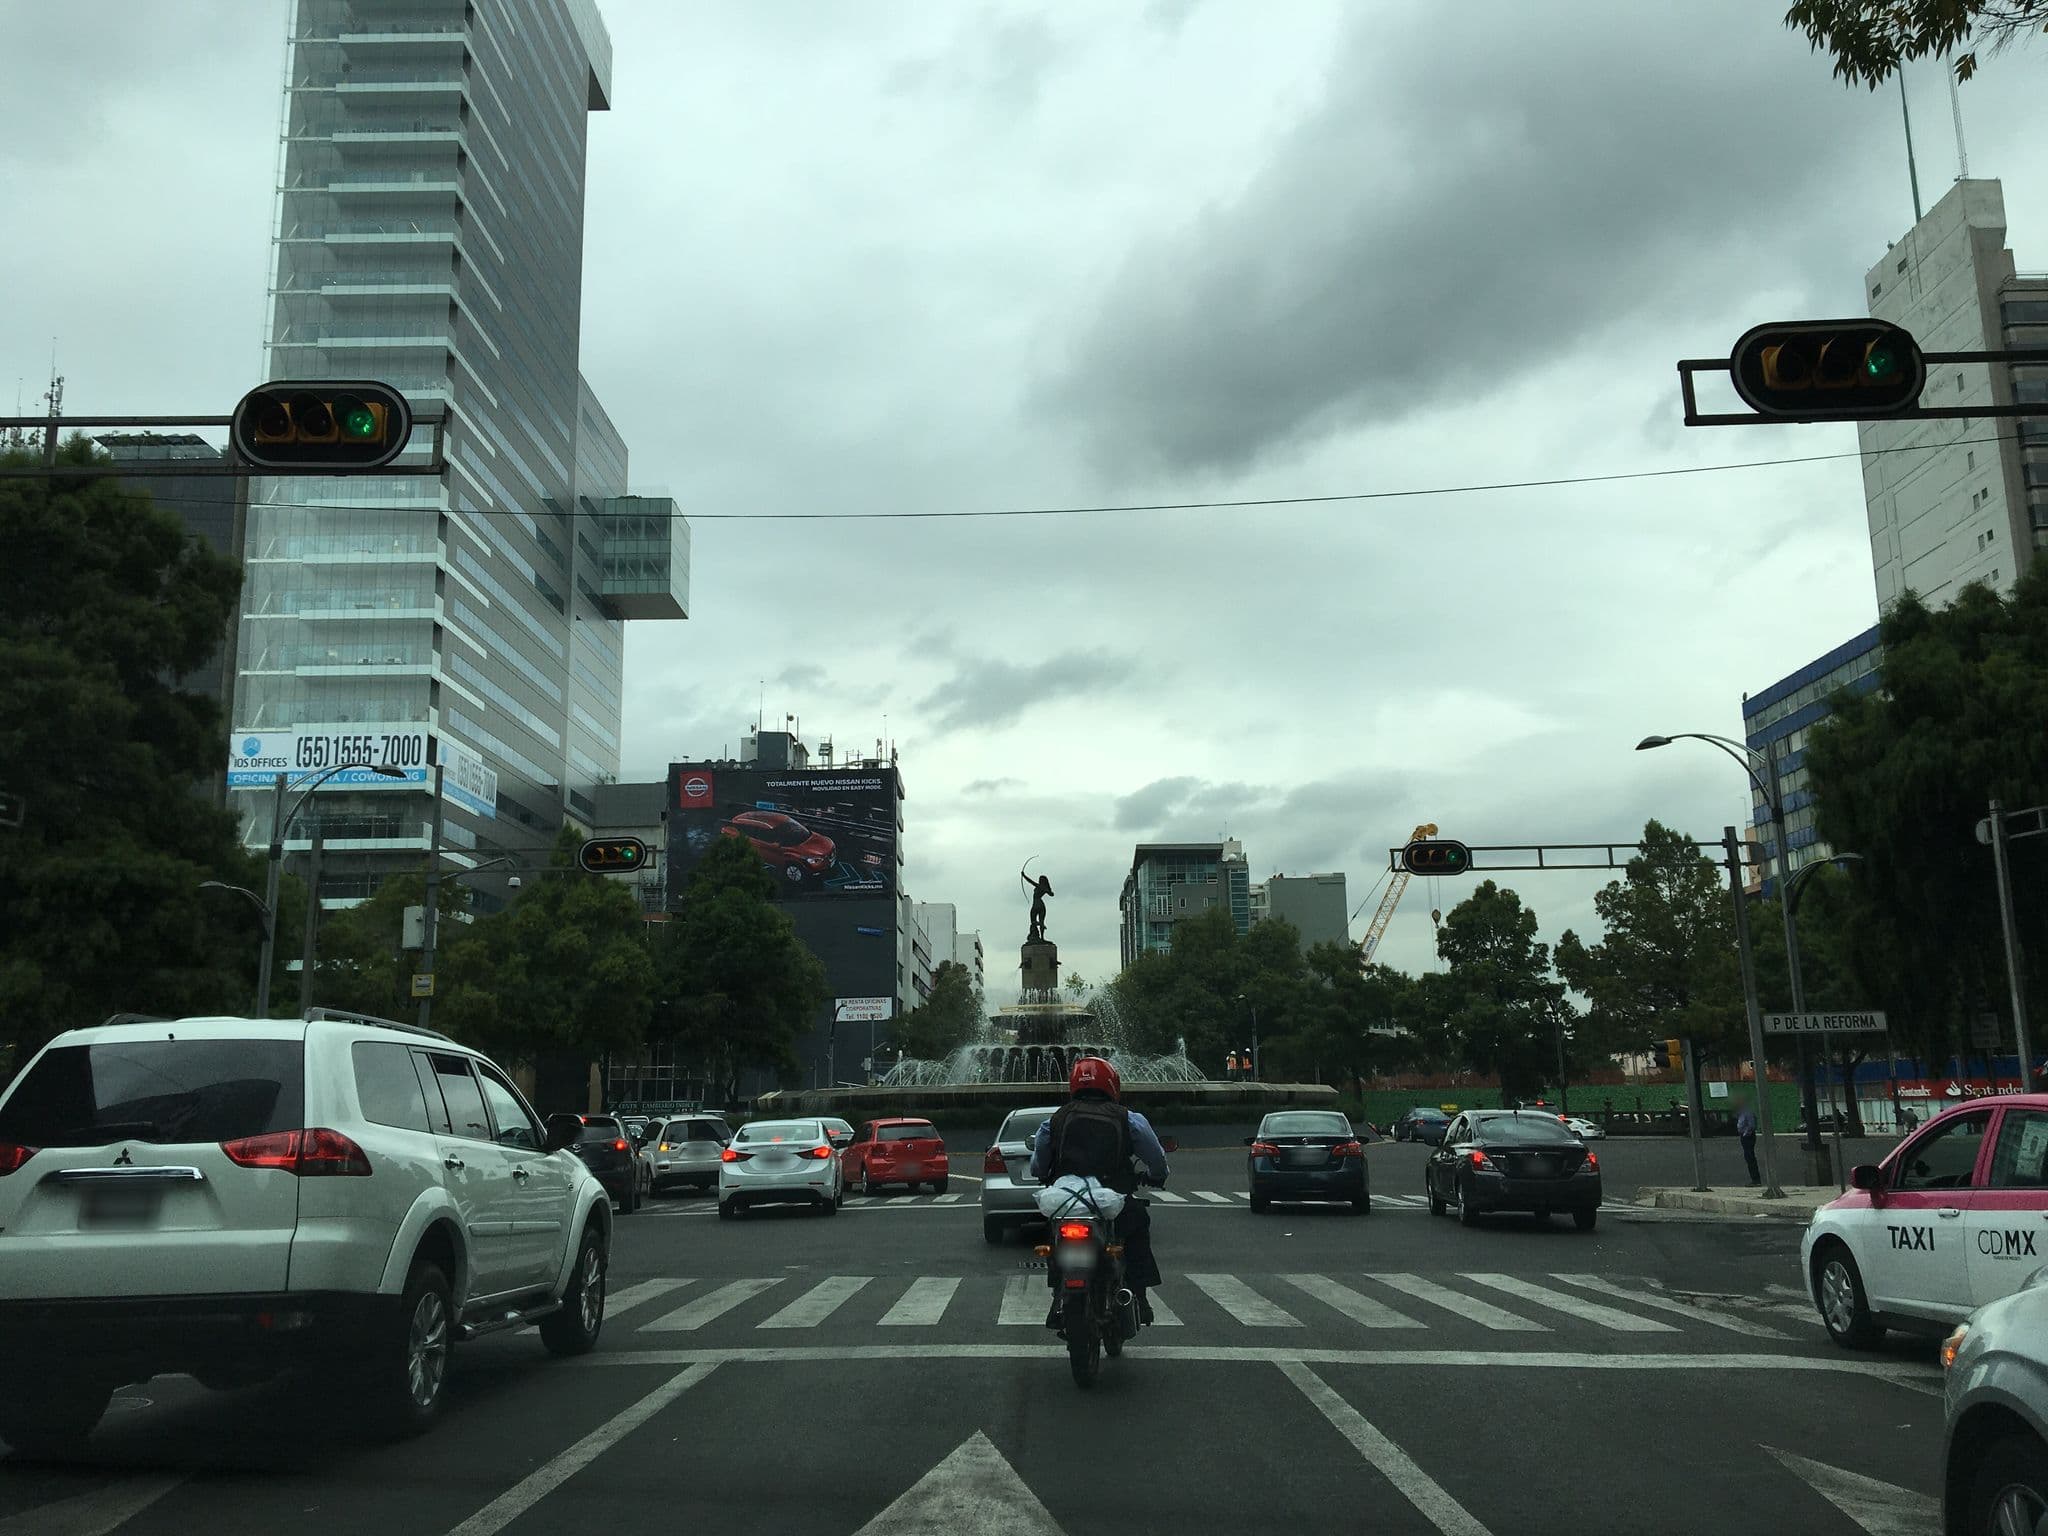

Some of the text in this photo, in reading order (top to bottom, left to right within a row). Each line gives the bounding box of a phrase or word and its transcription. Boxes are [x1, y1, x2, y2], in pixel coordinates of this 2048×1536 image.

[250, 757, 288, 768] OFFICES
[1773, 1015, 1878, 1030] P DE LA REFORMA
[1887, 1225, 2037, 1256] TAXI CDMX
